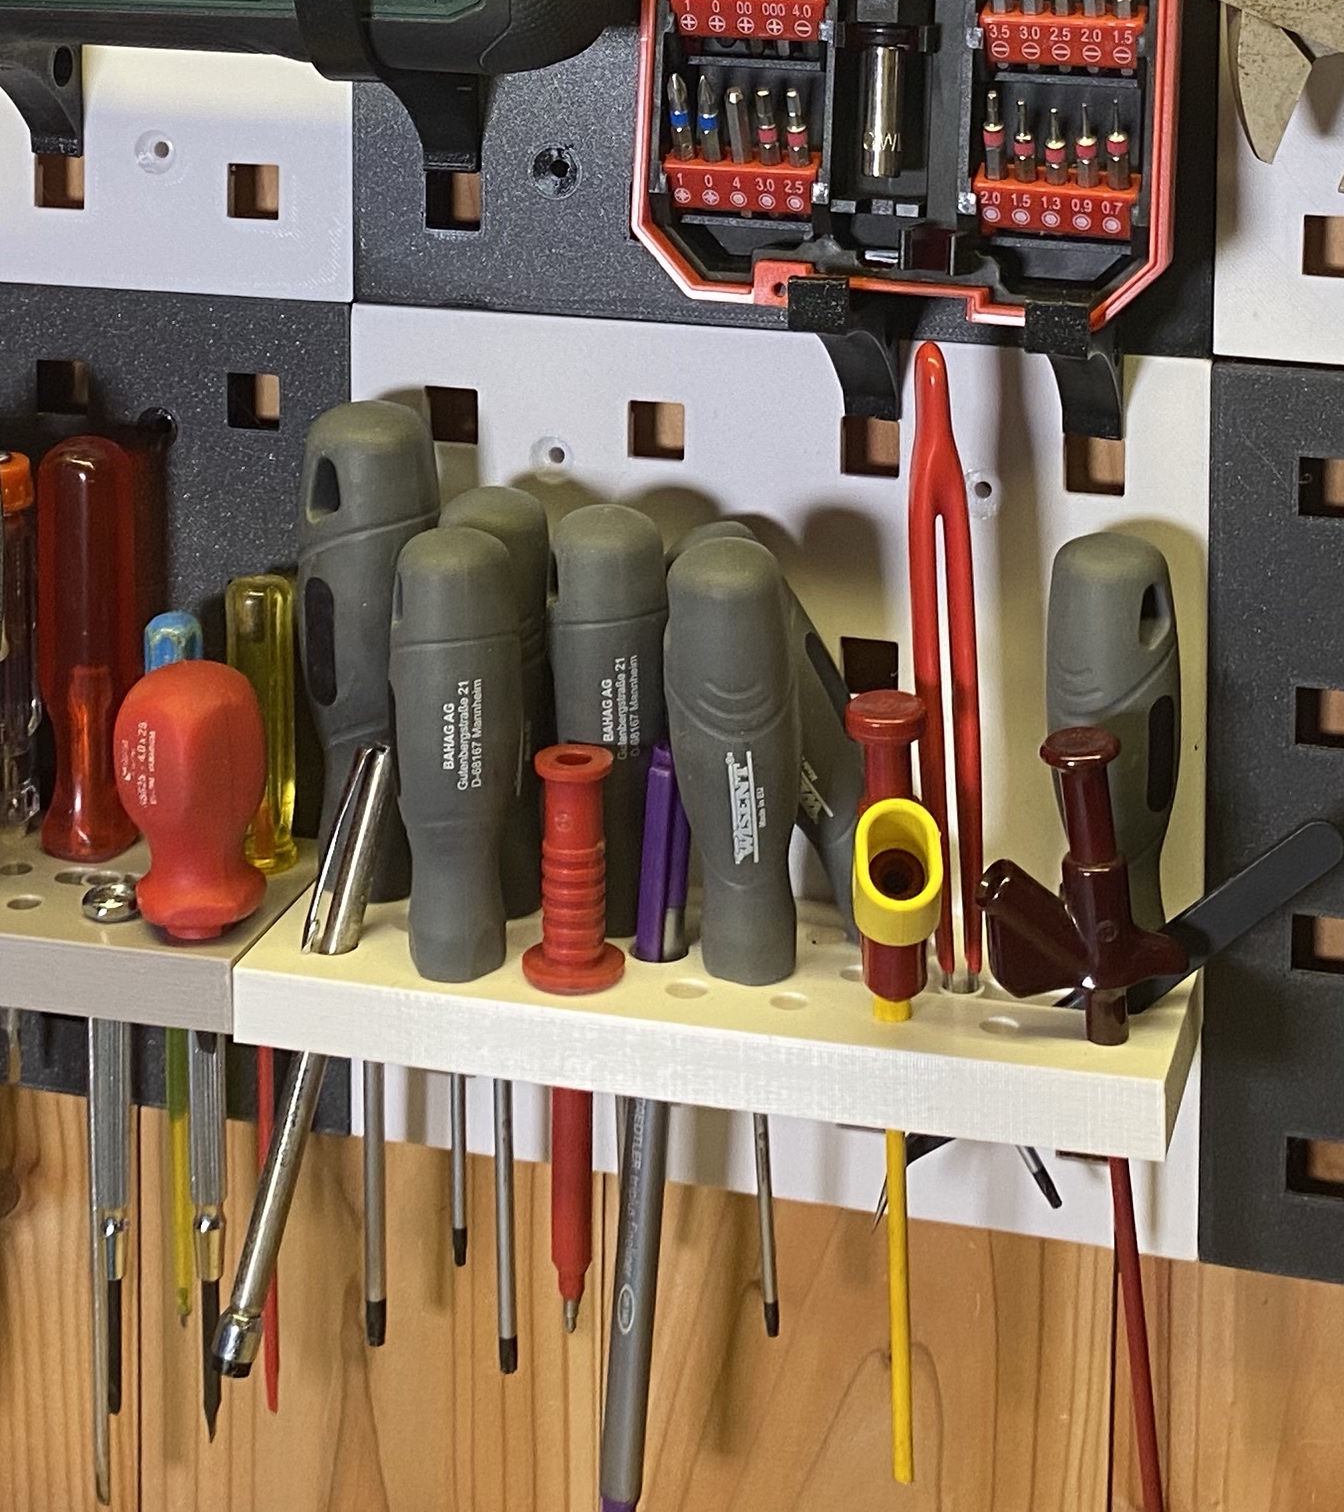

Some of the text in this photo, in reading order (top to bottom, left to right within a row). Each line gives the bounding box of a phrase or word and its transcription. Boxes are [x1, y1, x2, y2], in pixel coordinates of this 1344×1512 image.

[712, 0, 720, 12] 0
[737, 1, 752, 14] 00
[762, 2, 785, 16] 000
[792, 4, 811, 18] 4.0
[988, 24, 1133, 44] 3.5 3.0 2.5 2.0 1.5
[677, 173, 803, 193] 1 0 4 3.0 2.5
[980, 191, 1123, 215] 2.0 1.5 1.3 0.9 0.7
[615, 657, 626, 671] 21
[629, 655, 639, 711] Mannheim
[443, 703, 455, 770] BAHAG AG
[457, 680, 471, 791] Gutenbergstraße 21
[471, 678, 482, 788] D-68167 Mannheim
[601, 679, 614, 742] BAHAG AG
[732, 763, 754, 865] WISENT
